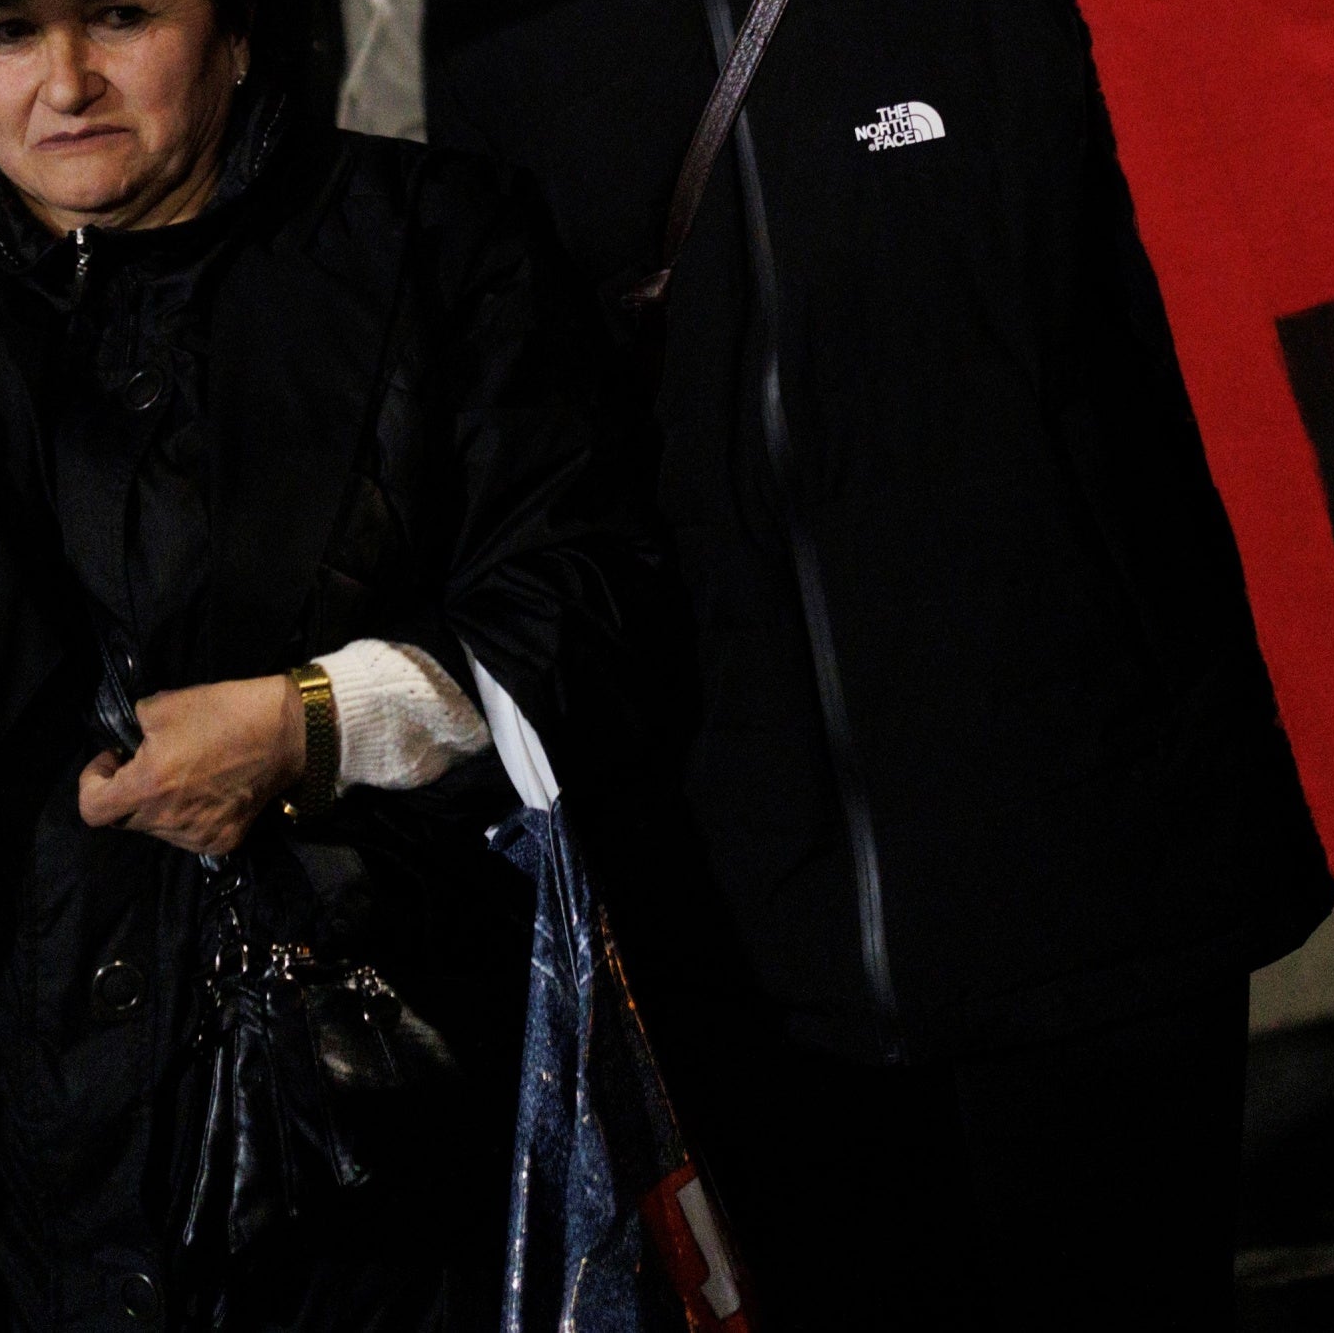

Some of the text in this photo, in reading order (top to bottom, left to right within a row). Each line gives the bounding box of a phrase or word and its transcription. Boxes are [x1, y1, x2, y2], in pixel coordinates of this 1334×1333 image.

[875, 102, 910, 123] THE
[854, 117, 913, 142] NORTH
[874, 130, 917, 152] FACE
